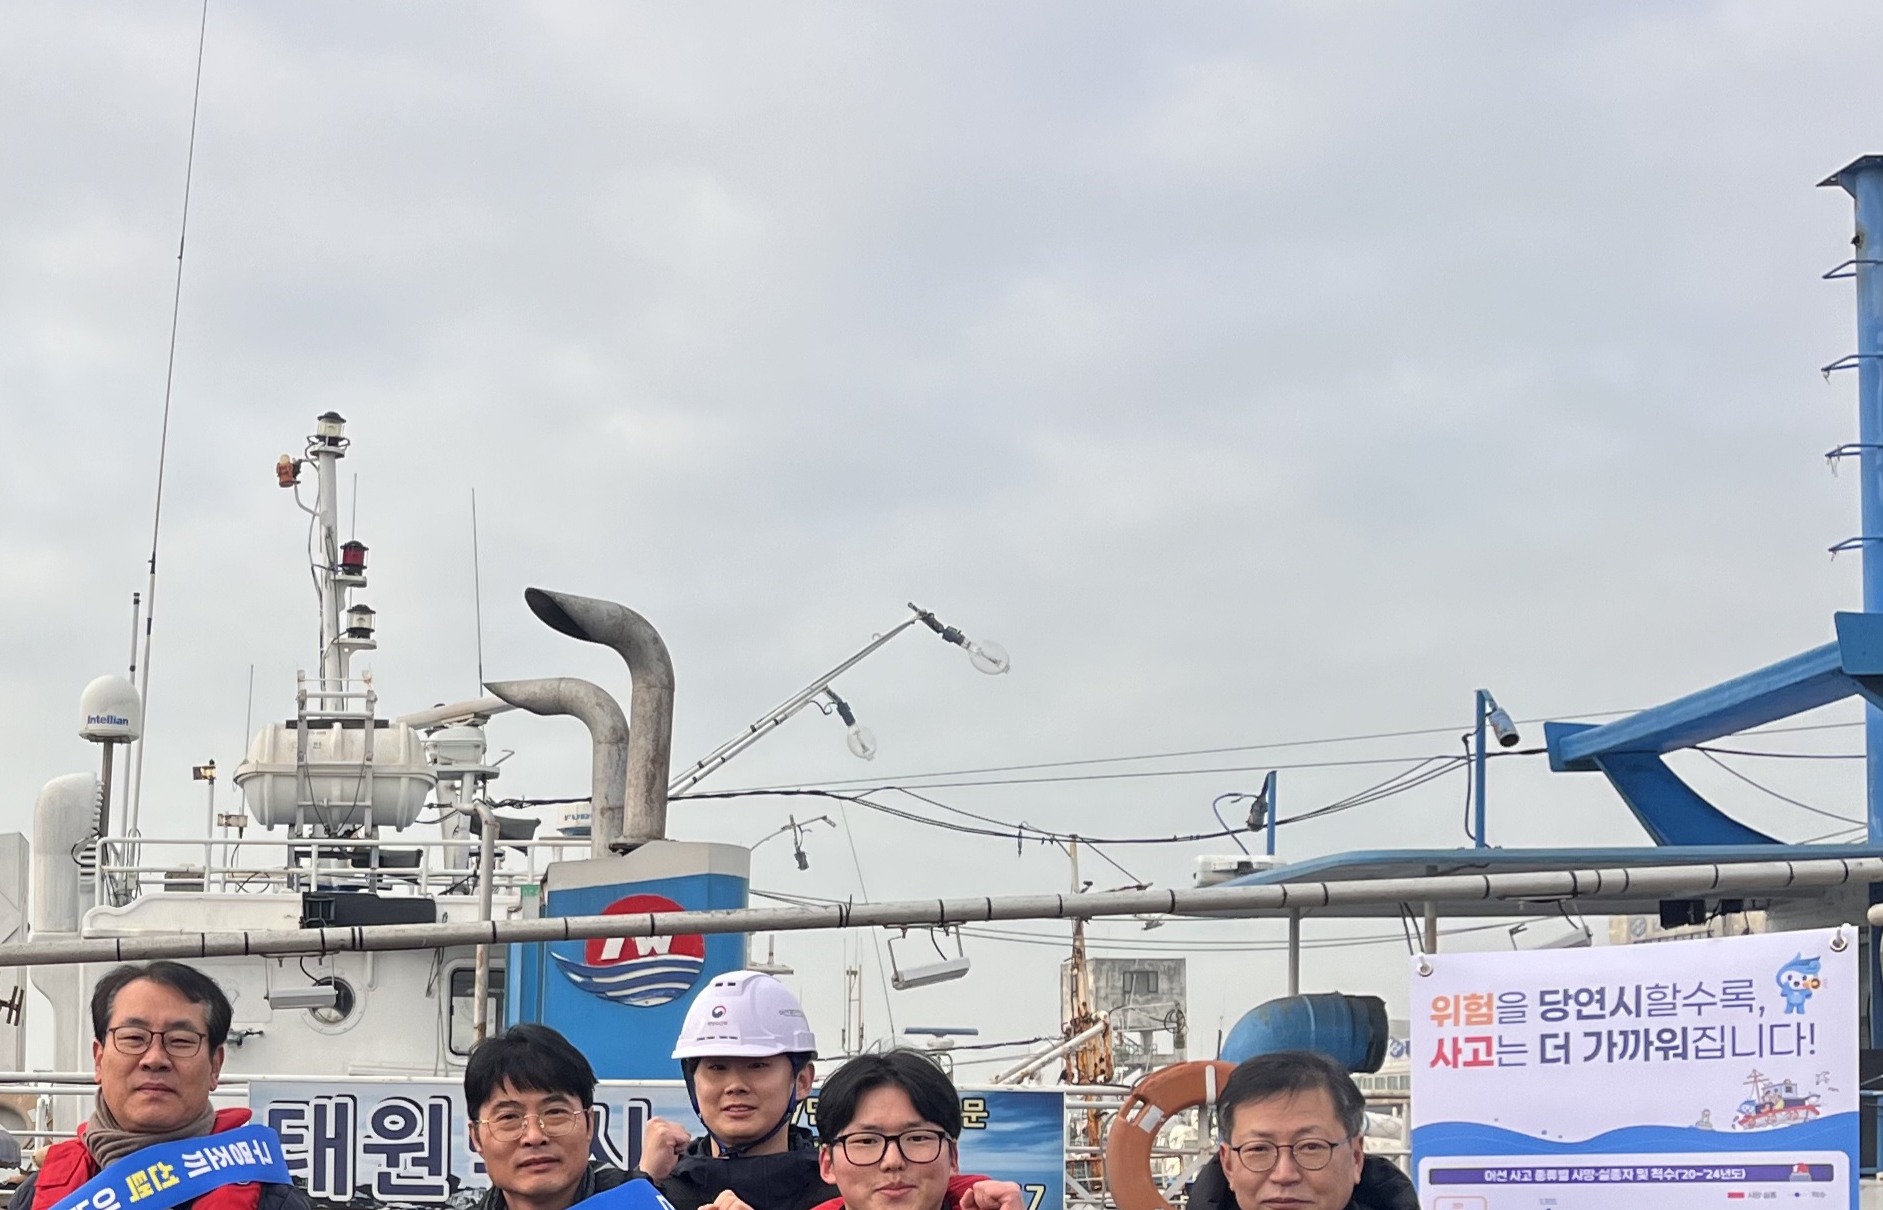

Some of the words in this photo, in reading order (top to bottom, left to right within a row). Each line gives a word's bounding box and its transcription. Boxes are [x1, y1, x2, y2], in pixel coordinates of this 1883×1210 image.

[87, 715, 129, 726] Intellian
[1430, 991, 1528, 1027] 위험을
[1539, 979, 1765, 1022] 당연시할수록,
[1430, 1035, 1528, 1069] 사고는
[1540, 1031, 1570, 1065] 더
[1583, 1022, 1815, 1063] 가까워집니다!
[181, 1139, 274, 1179] 구명조끼
[1485, 1169, 1508, 1182] 어선
[1510, 1169, 1533, 1182] 사고
[1535, 1169, 1570, 1182] 종류별
[1572, 1168, 1634, 1182] 사망·실종자
[1636, 1168, 1649, 1181] 및
[125, 1161, 180, 1203] 선택
